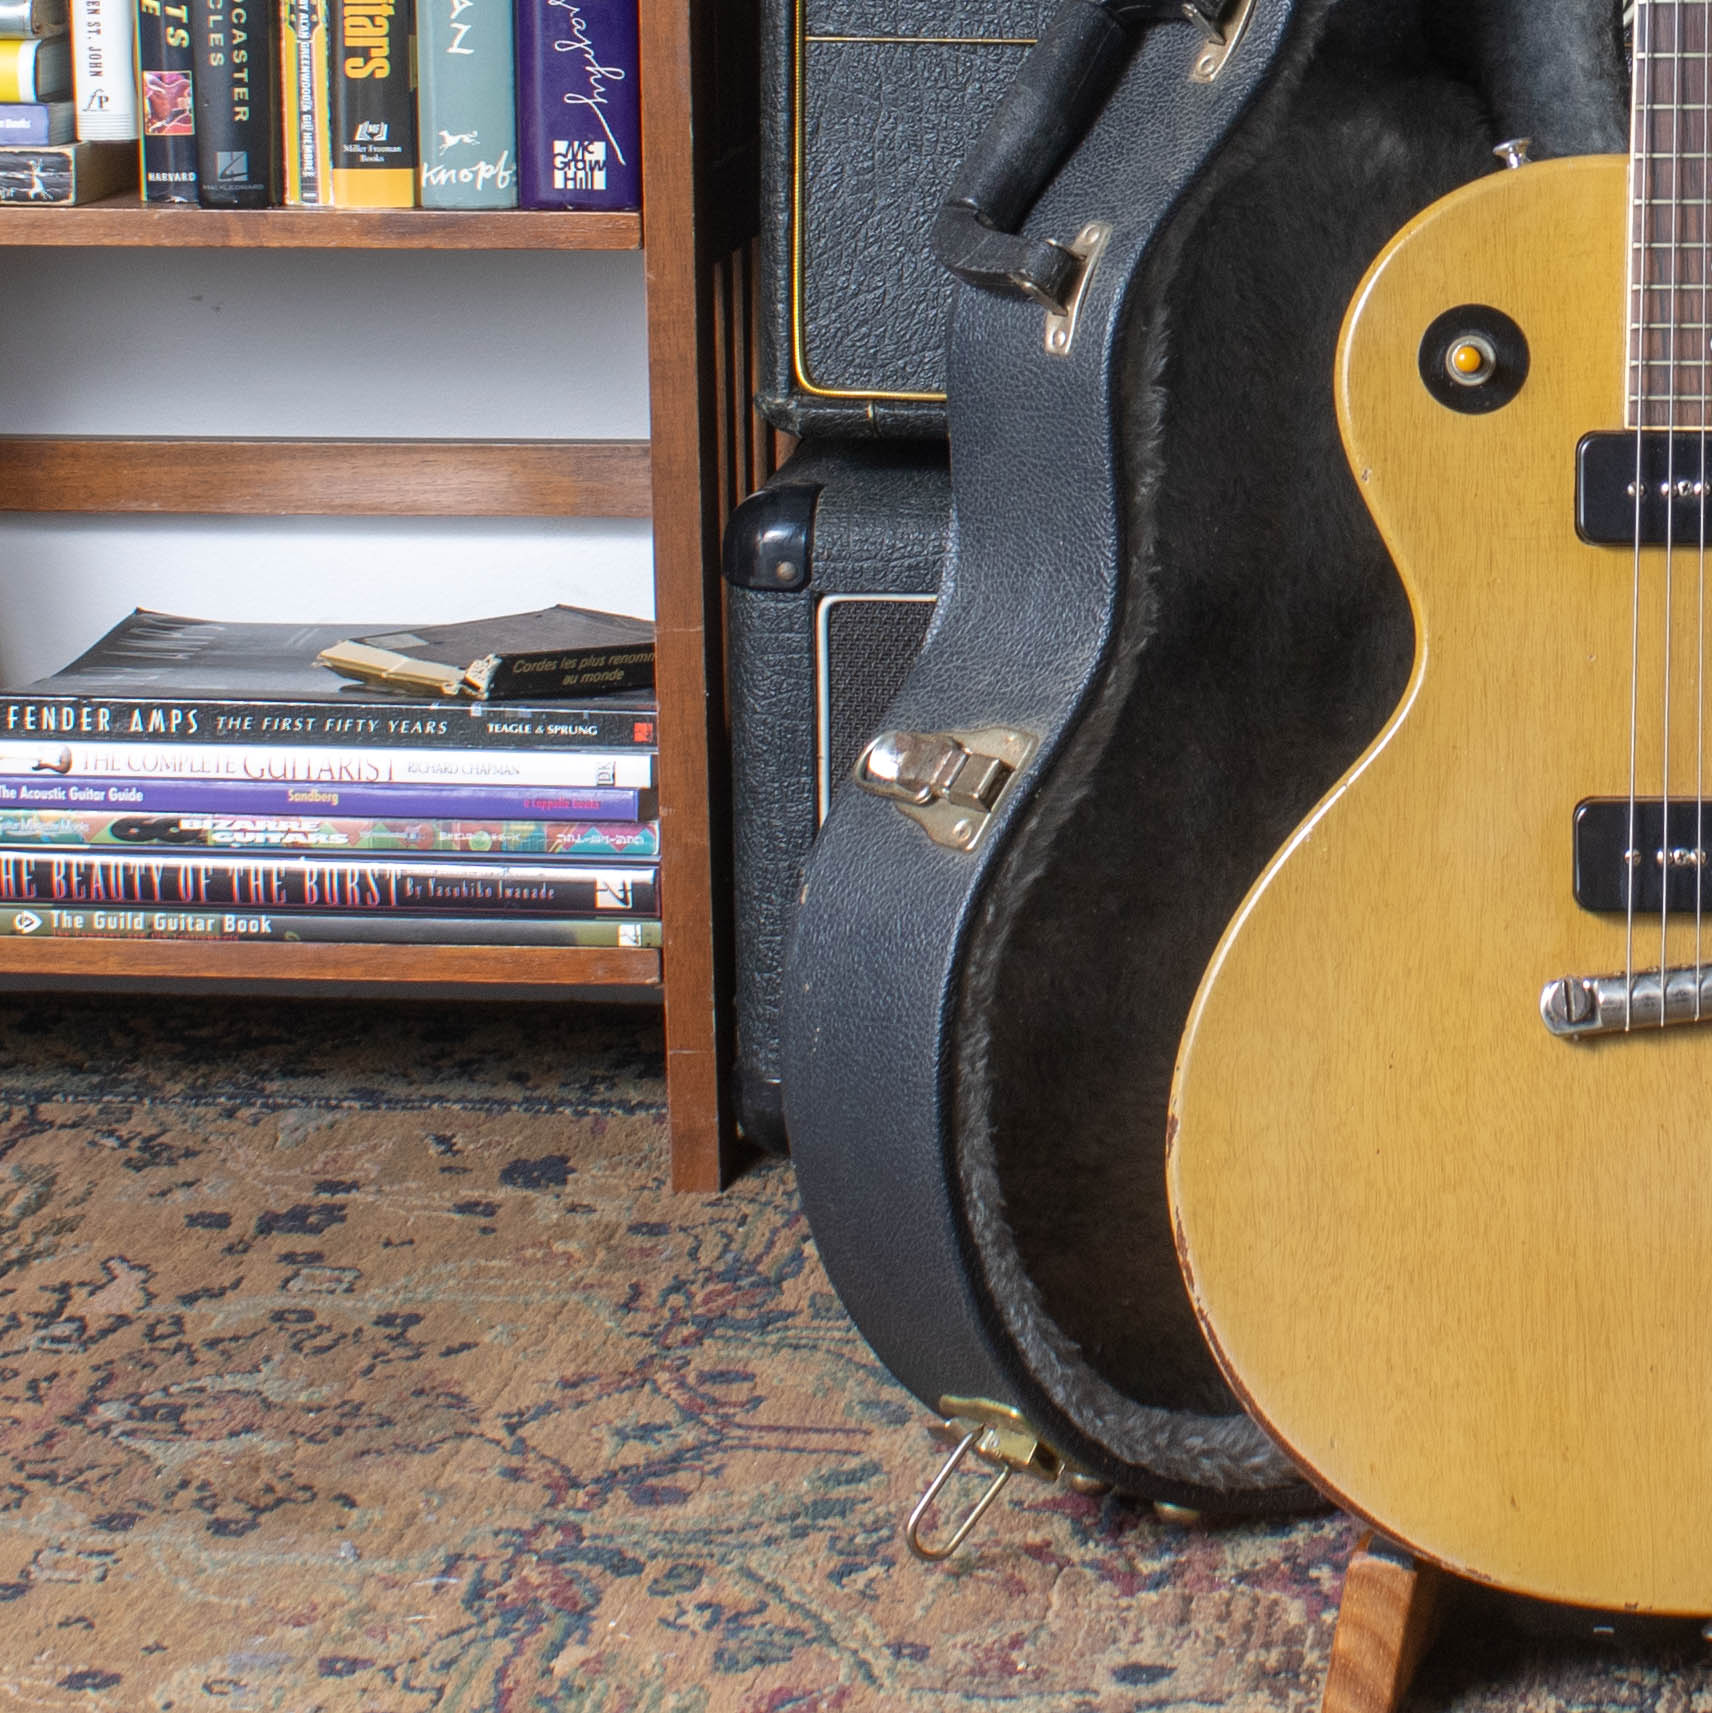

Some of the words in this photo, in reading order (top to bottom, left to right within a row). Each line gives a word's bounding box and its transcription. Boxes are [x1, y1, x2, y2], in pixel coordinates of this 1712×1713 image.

[87, 22, 101, 42] ST.
[89, 45, 102, 78] JOHN
[148, 171, 197, 182] HARVARD
[513, 659, 558, 673] Cordes
[560, 656, 577, 669] les
[578, 655, 606, 672] plus
[562, 675, 577, 685] au
[580, 669, 625, 683] monde
[7, 705, 111, 732] FENDER
[129, 707, 199, 734] AMPS
[216, 716, 253, 730] THE
[261, 717, 315, 731] FIRST
[324, 718, 380, 733] FIFTY
[388, 720, 448, 735] YEARS
[487, 722, 532, 735] TEAGLE
[546, 723, 598, 736] SPRUNG
[127, 752, 237, 775] COMPLETE
[19, 785, 66, 800] Acoustic
[68, 786, 105, 801] Guitar
[108, 787, 143, 802] Guide
[288, 789, 339, 806] Sandberg
[180, 819, 321, 834] BIZARRE
[211, 831, 349, 846] GUITARS
[52, 861, 164, 902] BEAUTY
[177, 863, 212, 904] OF
[229, 865, 288, 905] THE
[304, 867, 401, 907] BURST
[406, 877, 422, 899] By
[51, 910, 84, 929] The
[94, 911, 145, 931] Guild
[152, 912, 215, 933] Guitar
[222, 914, 272, 934] Book
